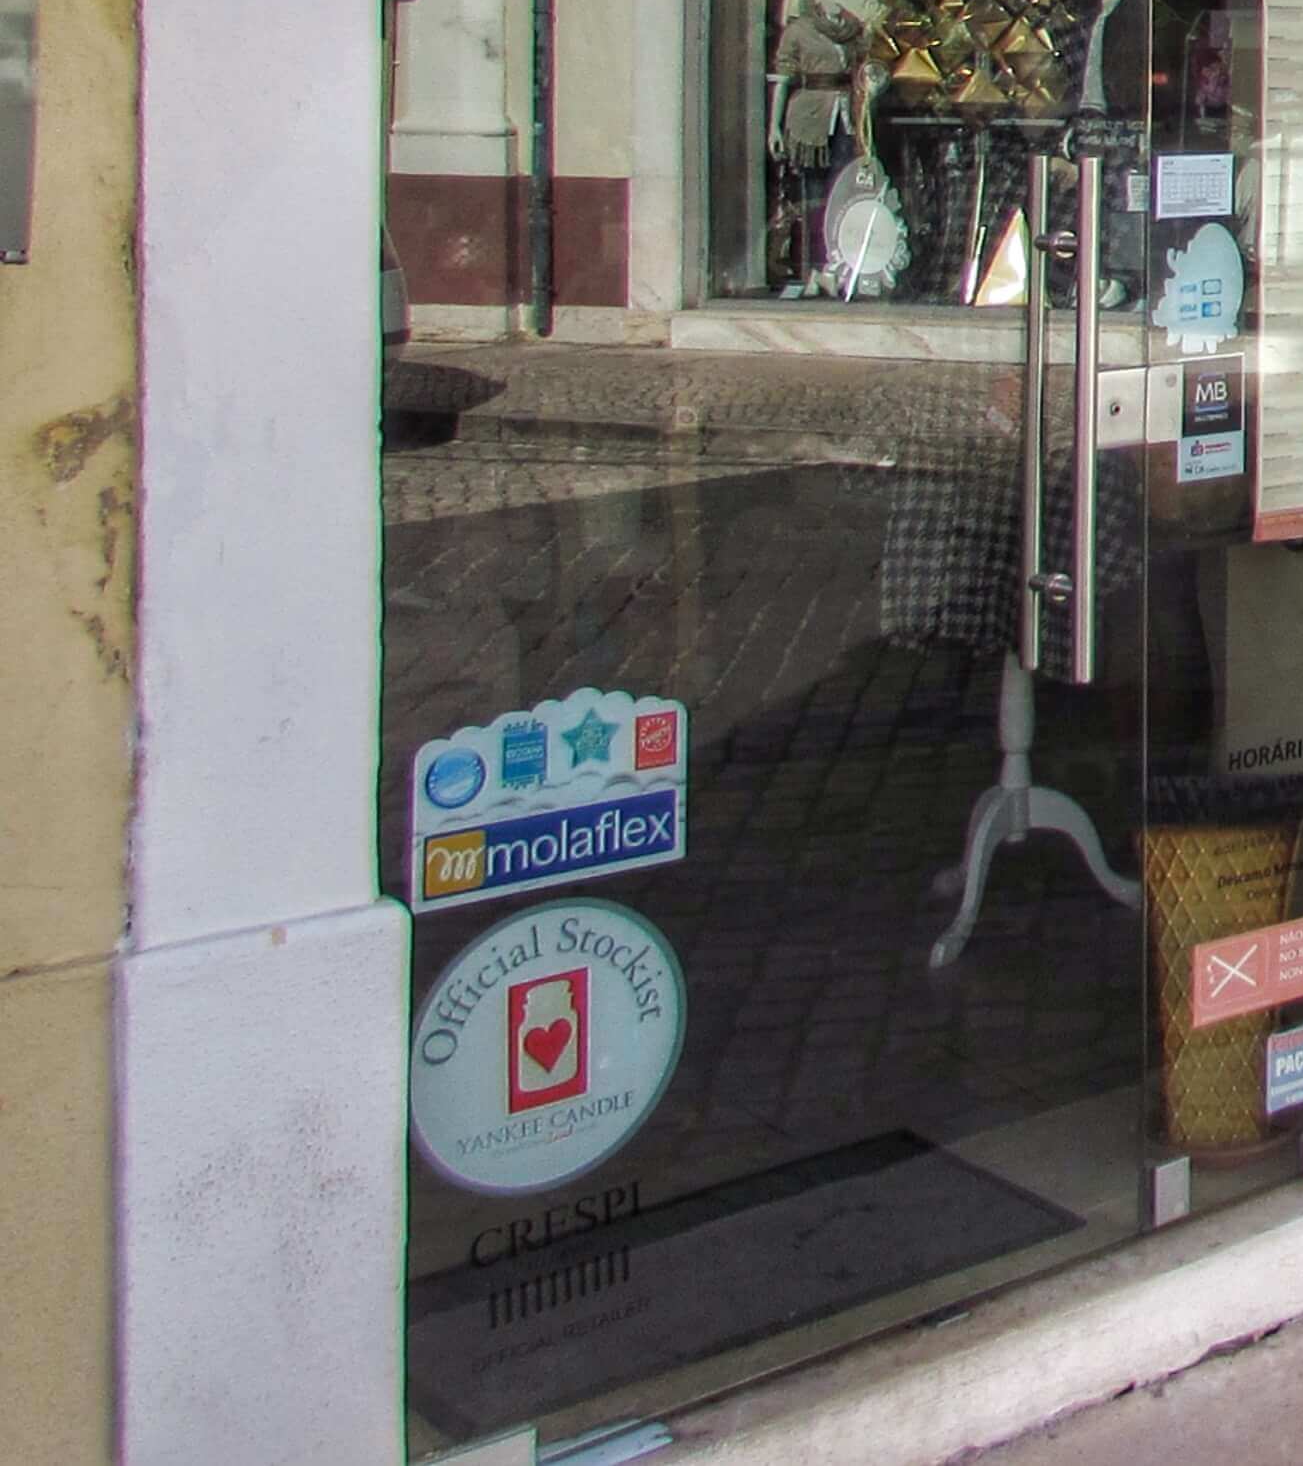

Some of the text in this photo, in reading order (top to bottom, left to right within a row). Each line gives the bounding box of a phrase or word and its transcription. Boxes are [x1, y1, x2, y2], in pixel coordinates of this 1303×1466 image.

[1195, 381, 1227, 403] MB
[487, 809, 671, 876] molaflex
[1280, 949, 1296, 963] NO
[1280, 965, 1303, 982] NON
[422, 917, 661, 1066] Official Stockist
[457, 1118, 543, 1154] YANKEE
[550, 1091, 634, 1127] CANDLE
[470, 1181, 641, 1269] CRESPI
